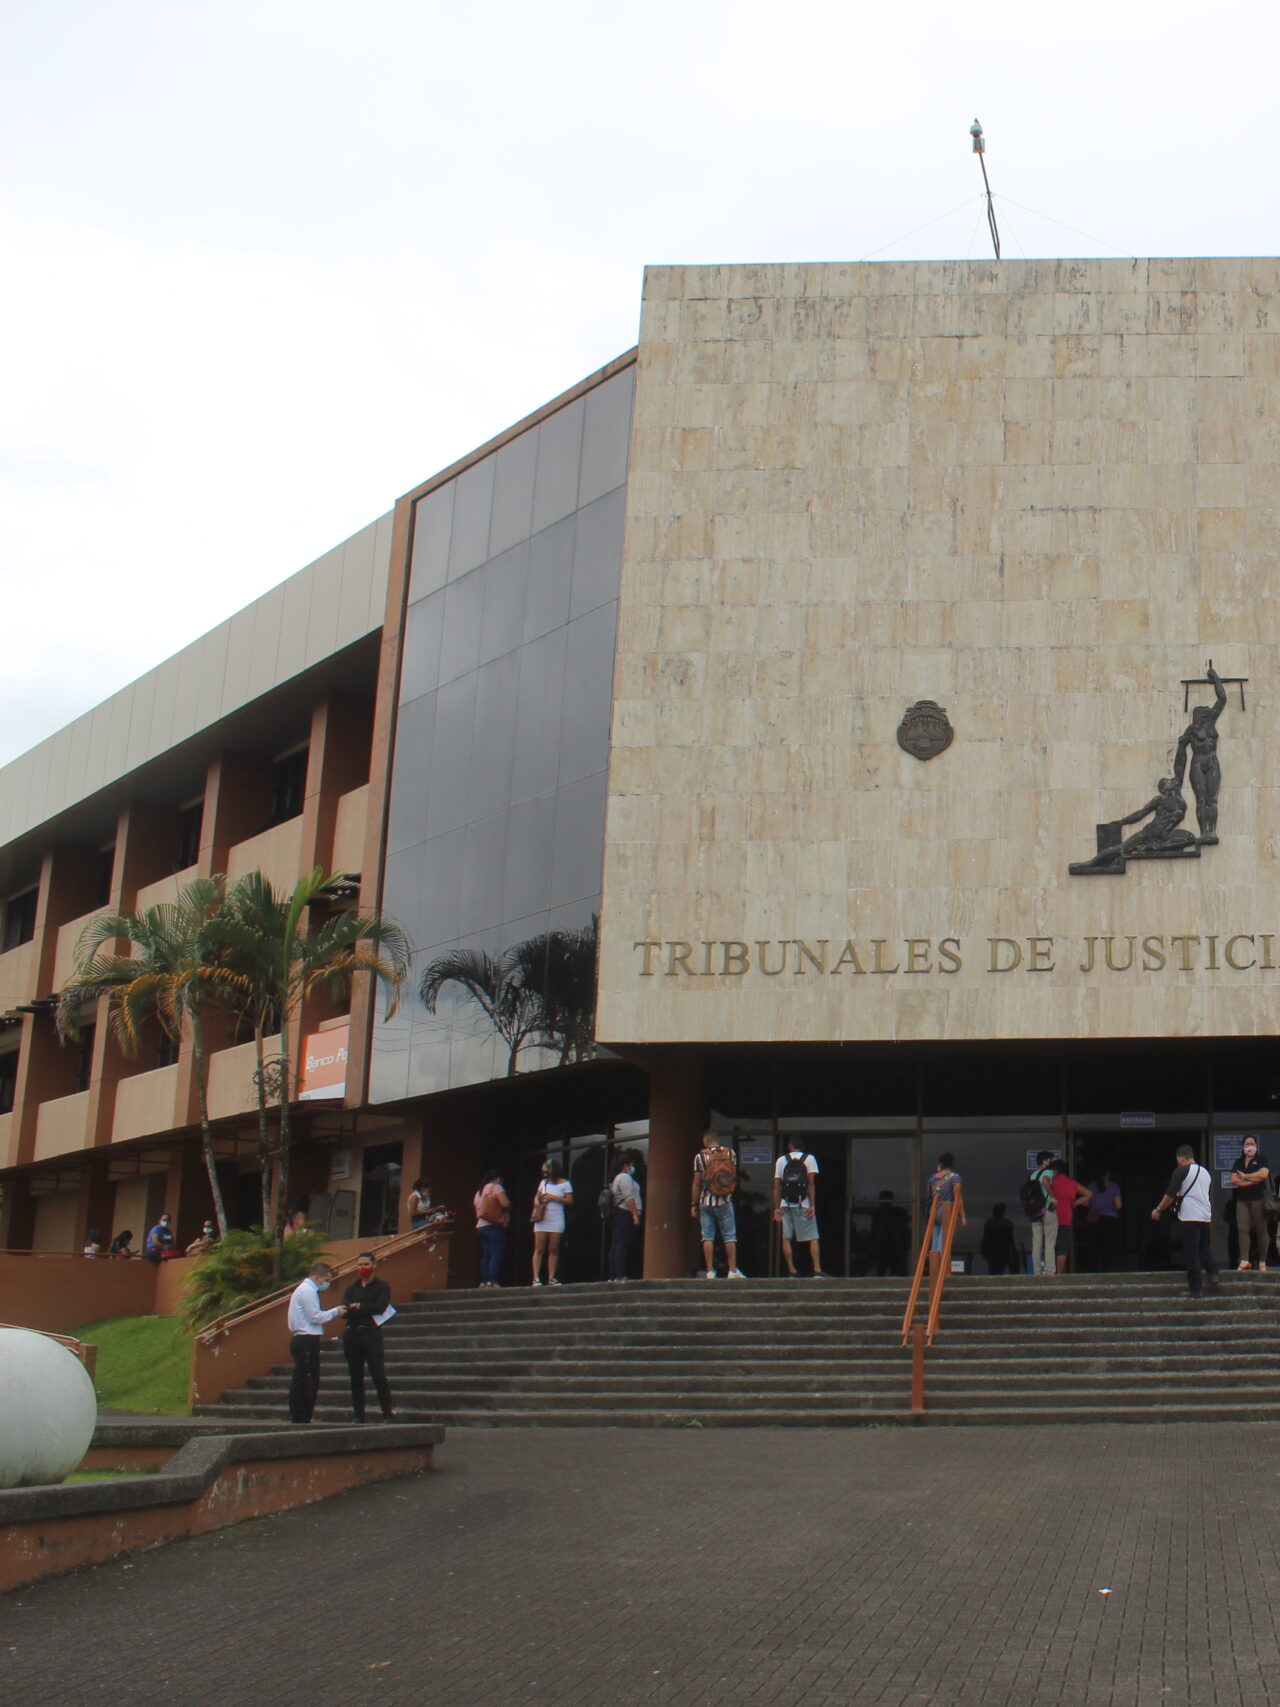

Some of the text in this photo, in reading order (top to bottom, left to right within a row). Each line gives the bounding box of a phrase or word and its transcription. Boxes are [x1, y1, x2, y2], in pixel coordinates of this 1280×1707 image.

[634, 938, 964, 977] TRIBUNALES
[987, 936, 1056, 973] DE
[305, 1046, 348, 1073] Banco Po
